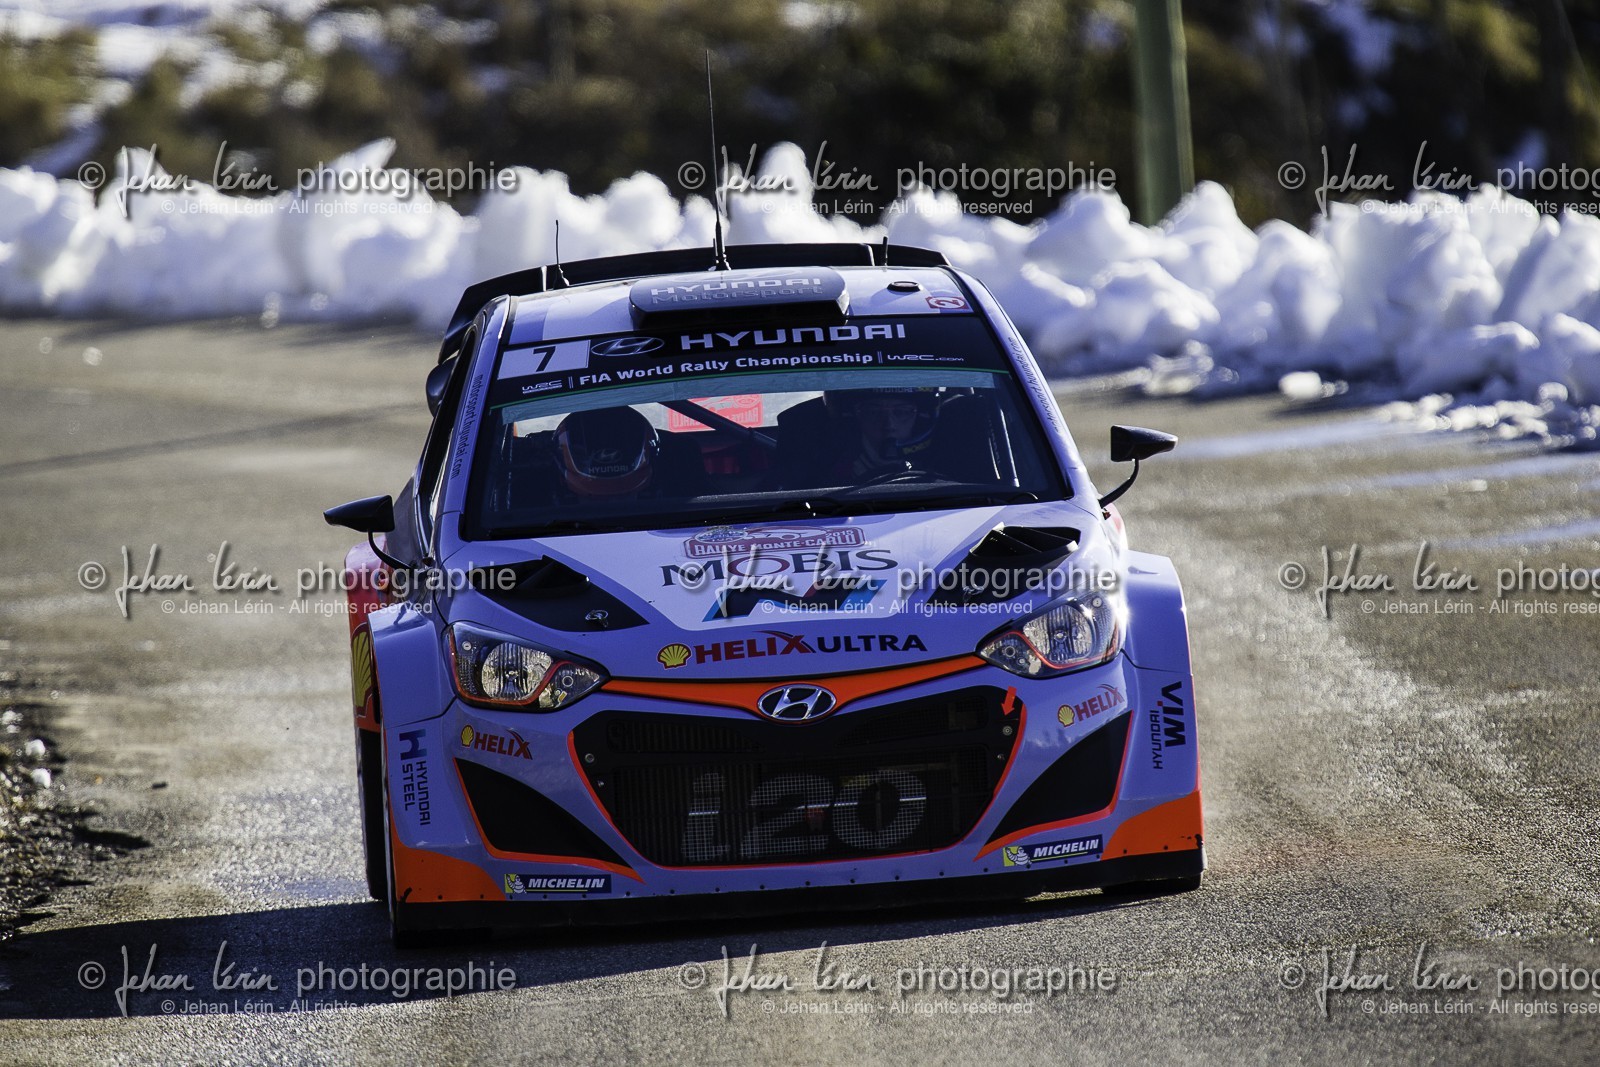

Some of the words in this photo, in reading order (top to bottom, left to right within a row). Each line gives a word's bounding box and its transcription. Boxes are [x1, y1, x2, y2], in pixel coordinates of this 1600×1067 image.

[651, 278, 822, 295] HYUNDAI
[652, 286, 823, 304] Motorsport
[681, 324, 906, 350] HYUNDAI
[532, 345, 556, 373] 7
[579, 373, 612, 386] FIA
[616, 364, 674, 380] World
[680, 360, 729, 375] Rally
[735, 352, 873, 369] Championship
[588, 465, 629, 474] HYUNDAI
[693, 543, 746, 556] RALLYE
[660, 549, 900, 587] MOBIS
[694, 631, 817, 664] HELIX
[816, 634, 929, 653] ULTRA
[1075, 683, 1126, 721] HELIX
[473, 728, 533, 760] HELIX
[1149, 709, 1163, 770] HYUNDAI
[402, 764, 416, 811] STEEL
[415, 760, 431, 826] HYUNDAI
[680, 769, 927, 861] i20
[1033, 839, 1099, 858] MICHELIN
[528, 877, 605, 888] MICHELIN
